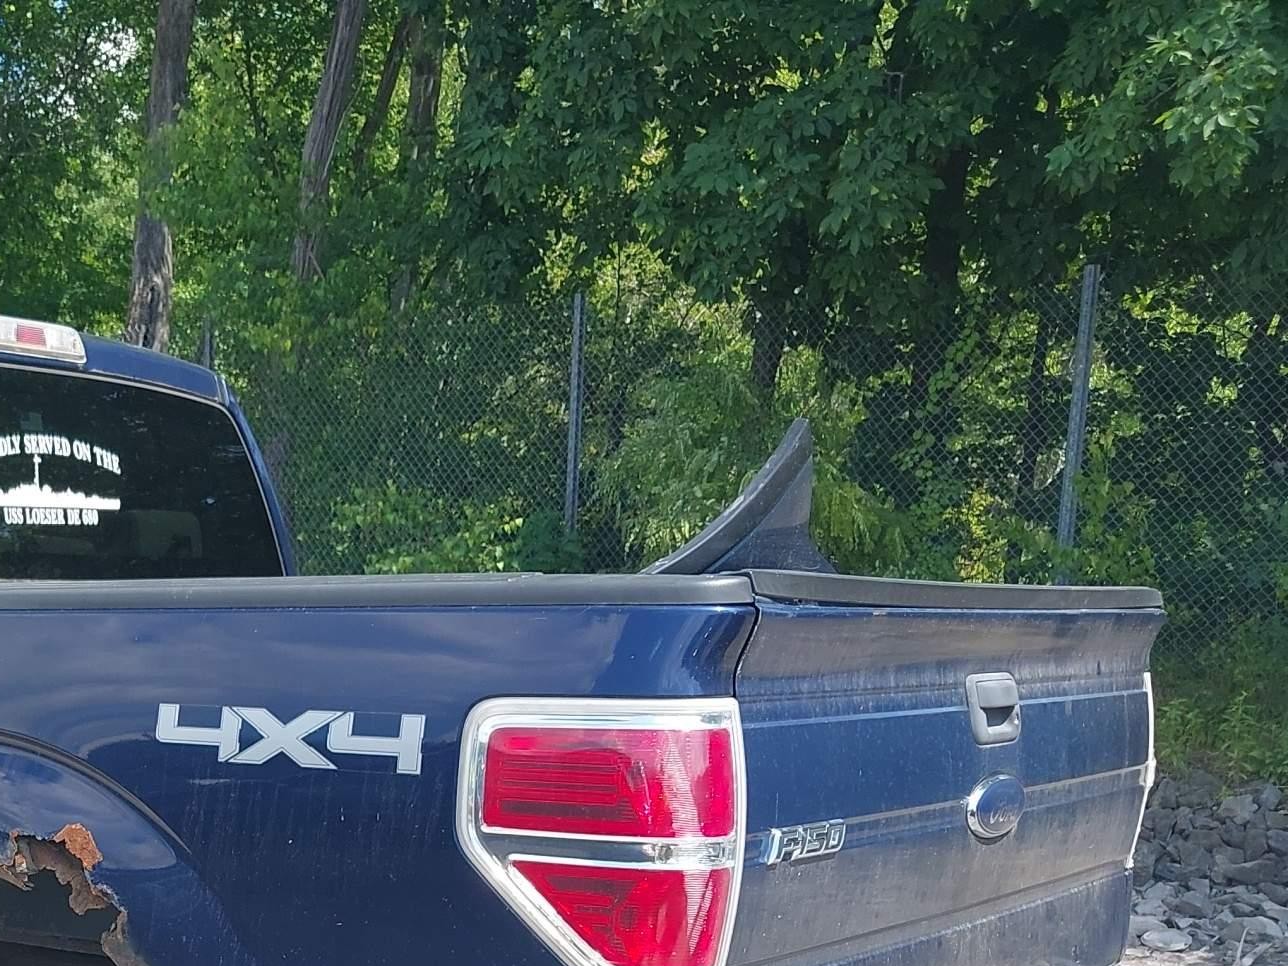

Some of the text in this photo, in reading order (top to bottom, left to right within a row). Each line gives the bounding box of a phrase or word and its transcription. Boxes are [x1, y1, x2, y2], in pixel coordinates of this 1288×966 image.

[23, 433, 71, 458] SERVED
[72, 439, 92, 463] ON
[93, 446, 122, 476] THE
[3, 507, 99, 526] USS LOESER DE 680
